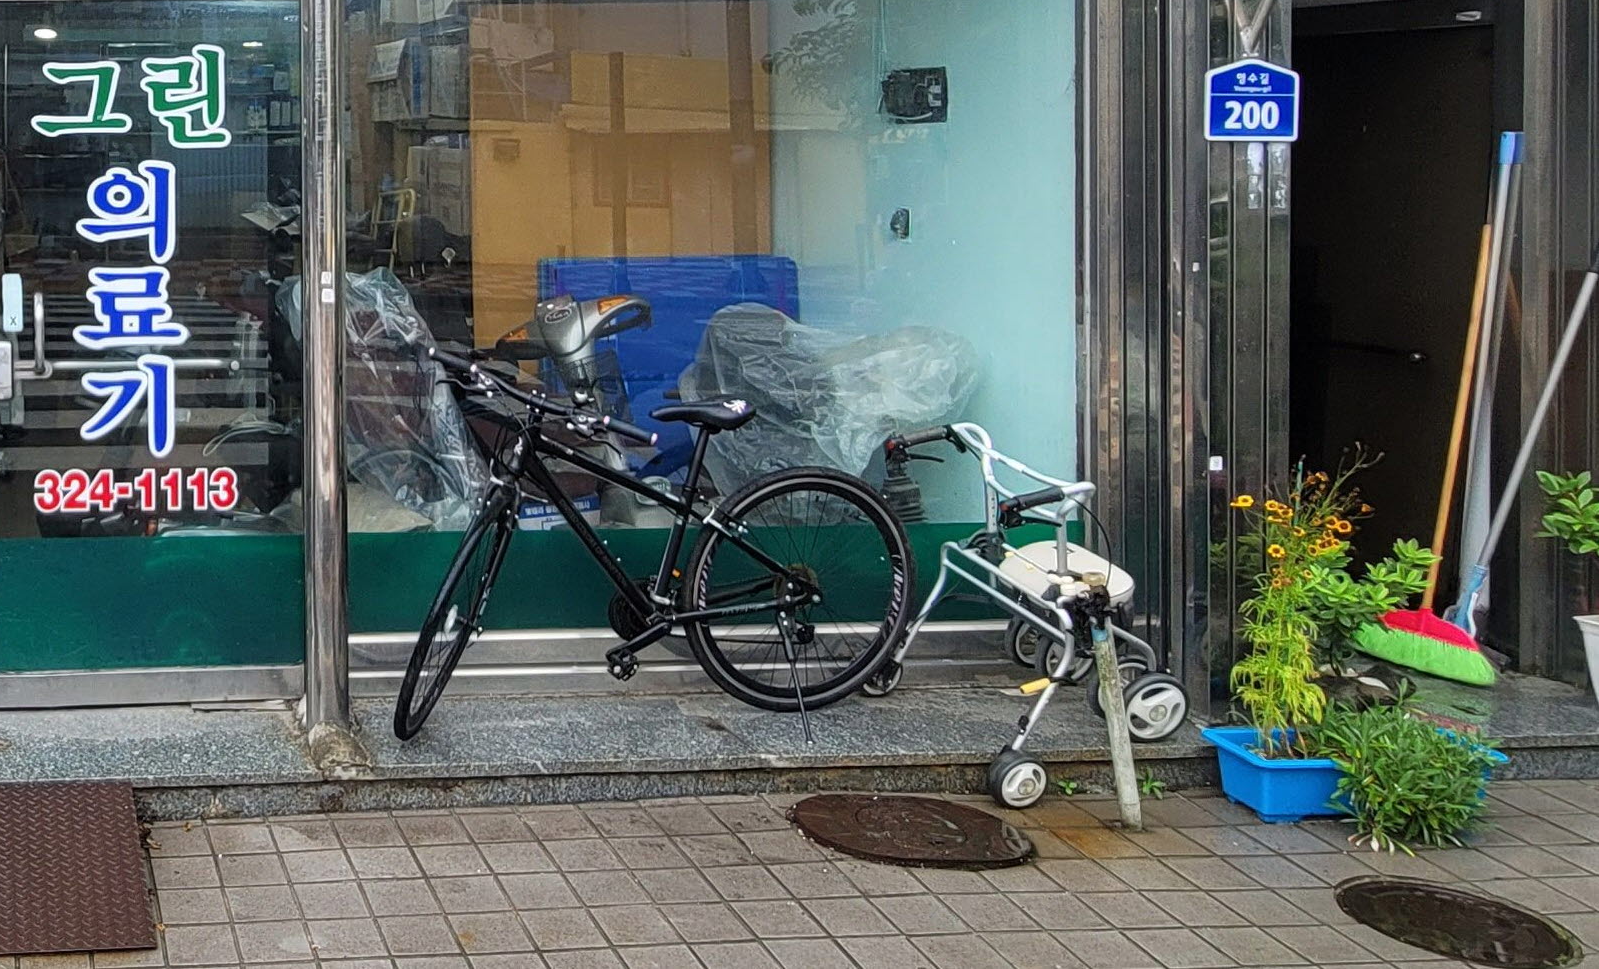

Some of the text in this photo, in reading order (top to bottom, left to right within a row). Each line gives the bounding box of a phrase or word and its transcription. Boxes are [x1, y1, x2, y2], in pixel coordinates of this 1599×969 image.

[31, 44, 232, 148] 그린
[1236, 72, 1270, 85] 영수길
[1224, 100, 1280, 130] 200
[34, 467, 239, 512] 324-1113
